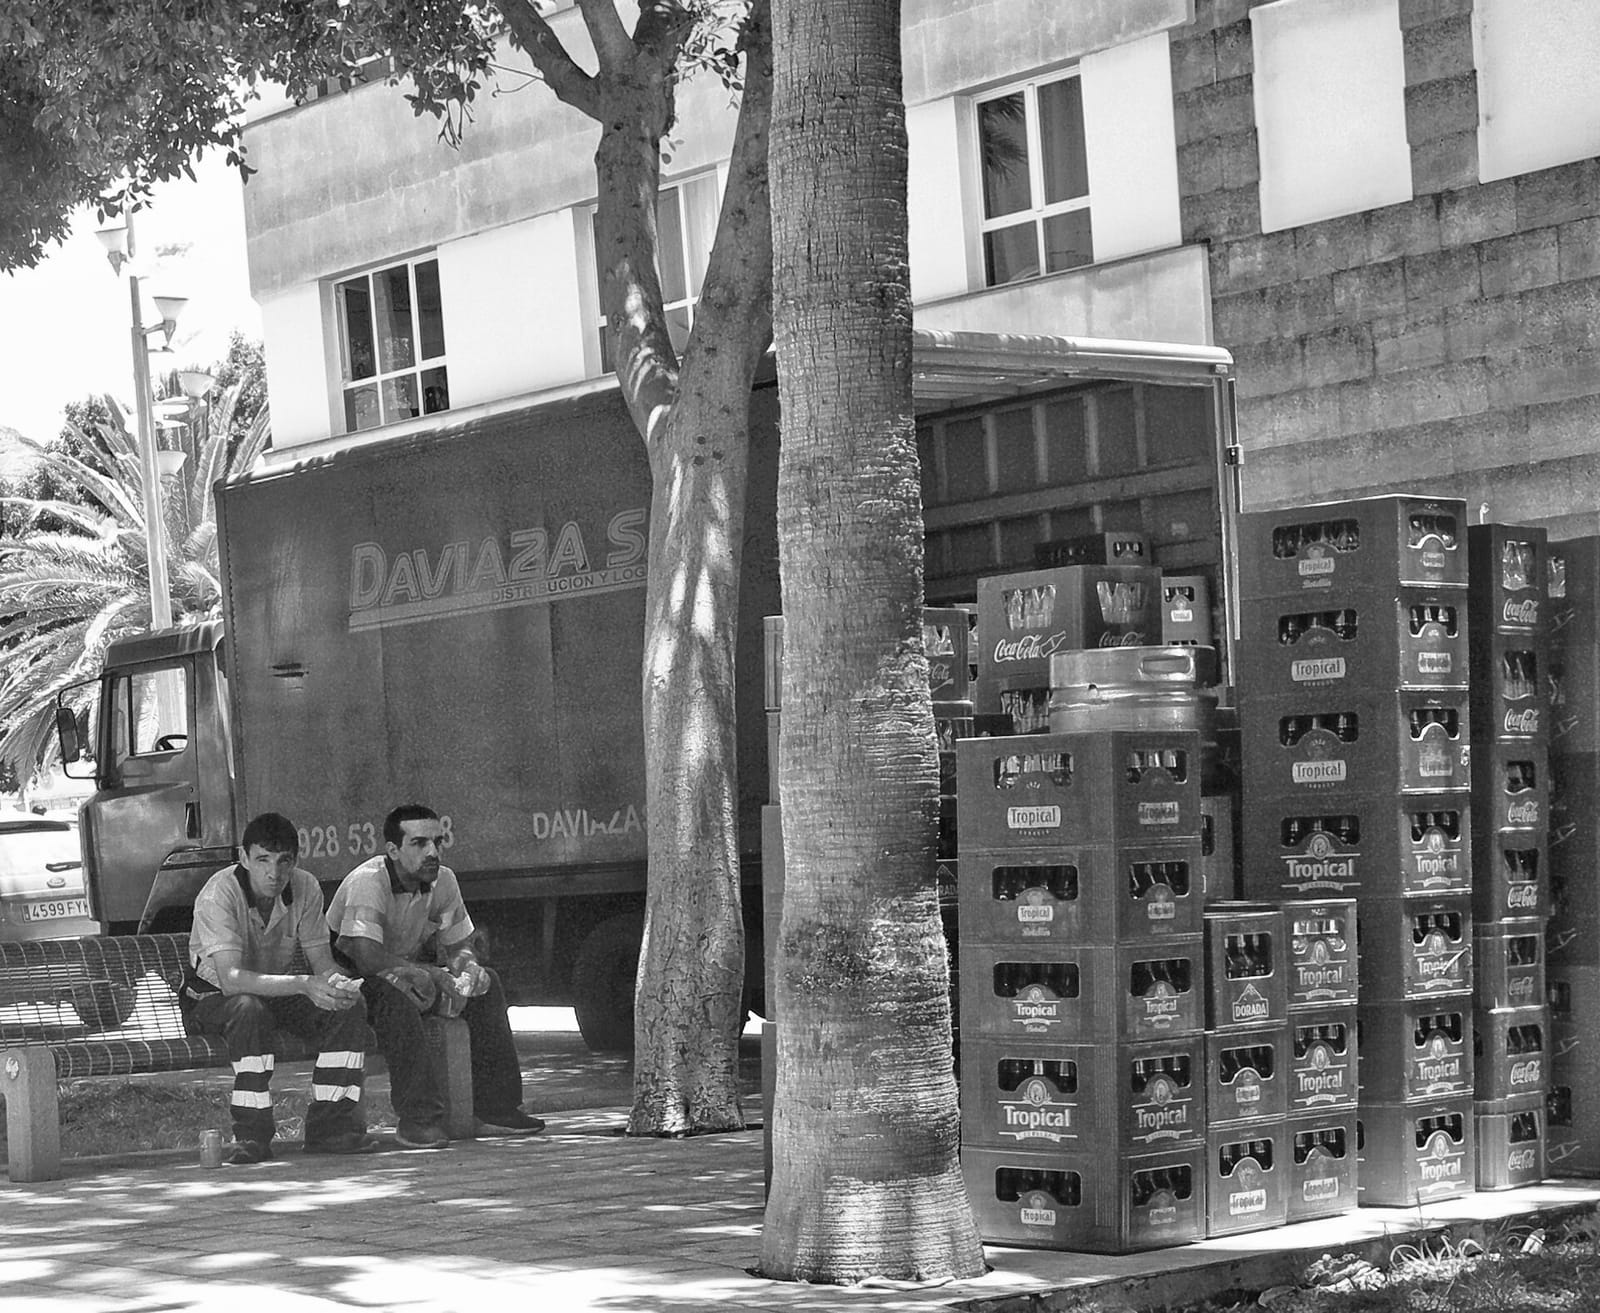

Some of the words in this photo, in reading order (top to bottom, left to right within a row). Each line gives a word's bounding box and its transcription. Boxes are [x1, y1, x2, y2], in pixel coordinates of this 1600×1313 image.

[350, 520, 591, 608] DAVIAZA
[492, 576, 594, 601] DISTRIBUCION
[600, 572, 608, 583] Y
[1295, 660, 1341, 677] Tropical
[1295, 762, 1341, 779] Tropical
[1011, 808, 1056, 826] Tropical
[298, 825, 340, 859] 928
[349, 822, 377, 855] 53
[1286, 859, 1354, 881] Tropical
[1416, 855, 1457, 876] Tropical
[32, 903, 65, 918] 4599
[1297, 966, 1343, 988] Tropical
[1016, 1003, 1057, 1019] Tropical
[1146, 1000, 1177, 1016] Tropical
[1235, 1003, 1267, 1017] DORADA
[1418, 1059, 1460, 1081] Tropical
[1297, 1070, 1343, 1093] Tropical
[1003, 1105, 1071, 1129] Tropical
[1136, 1105, 1187, 1129] Tropical
[1420, 1158, 1461, 1180] Tropical
